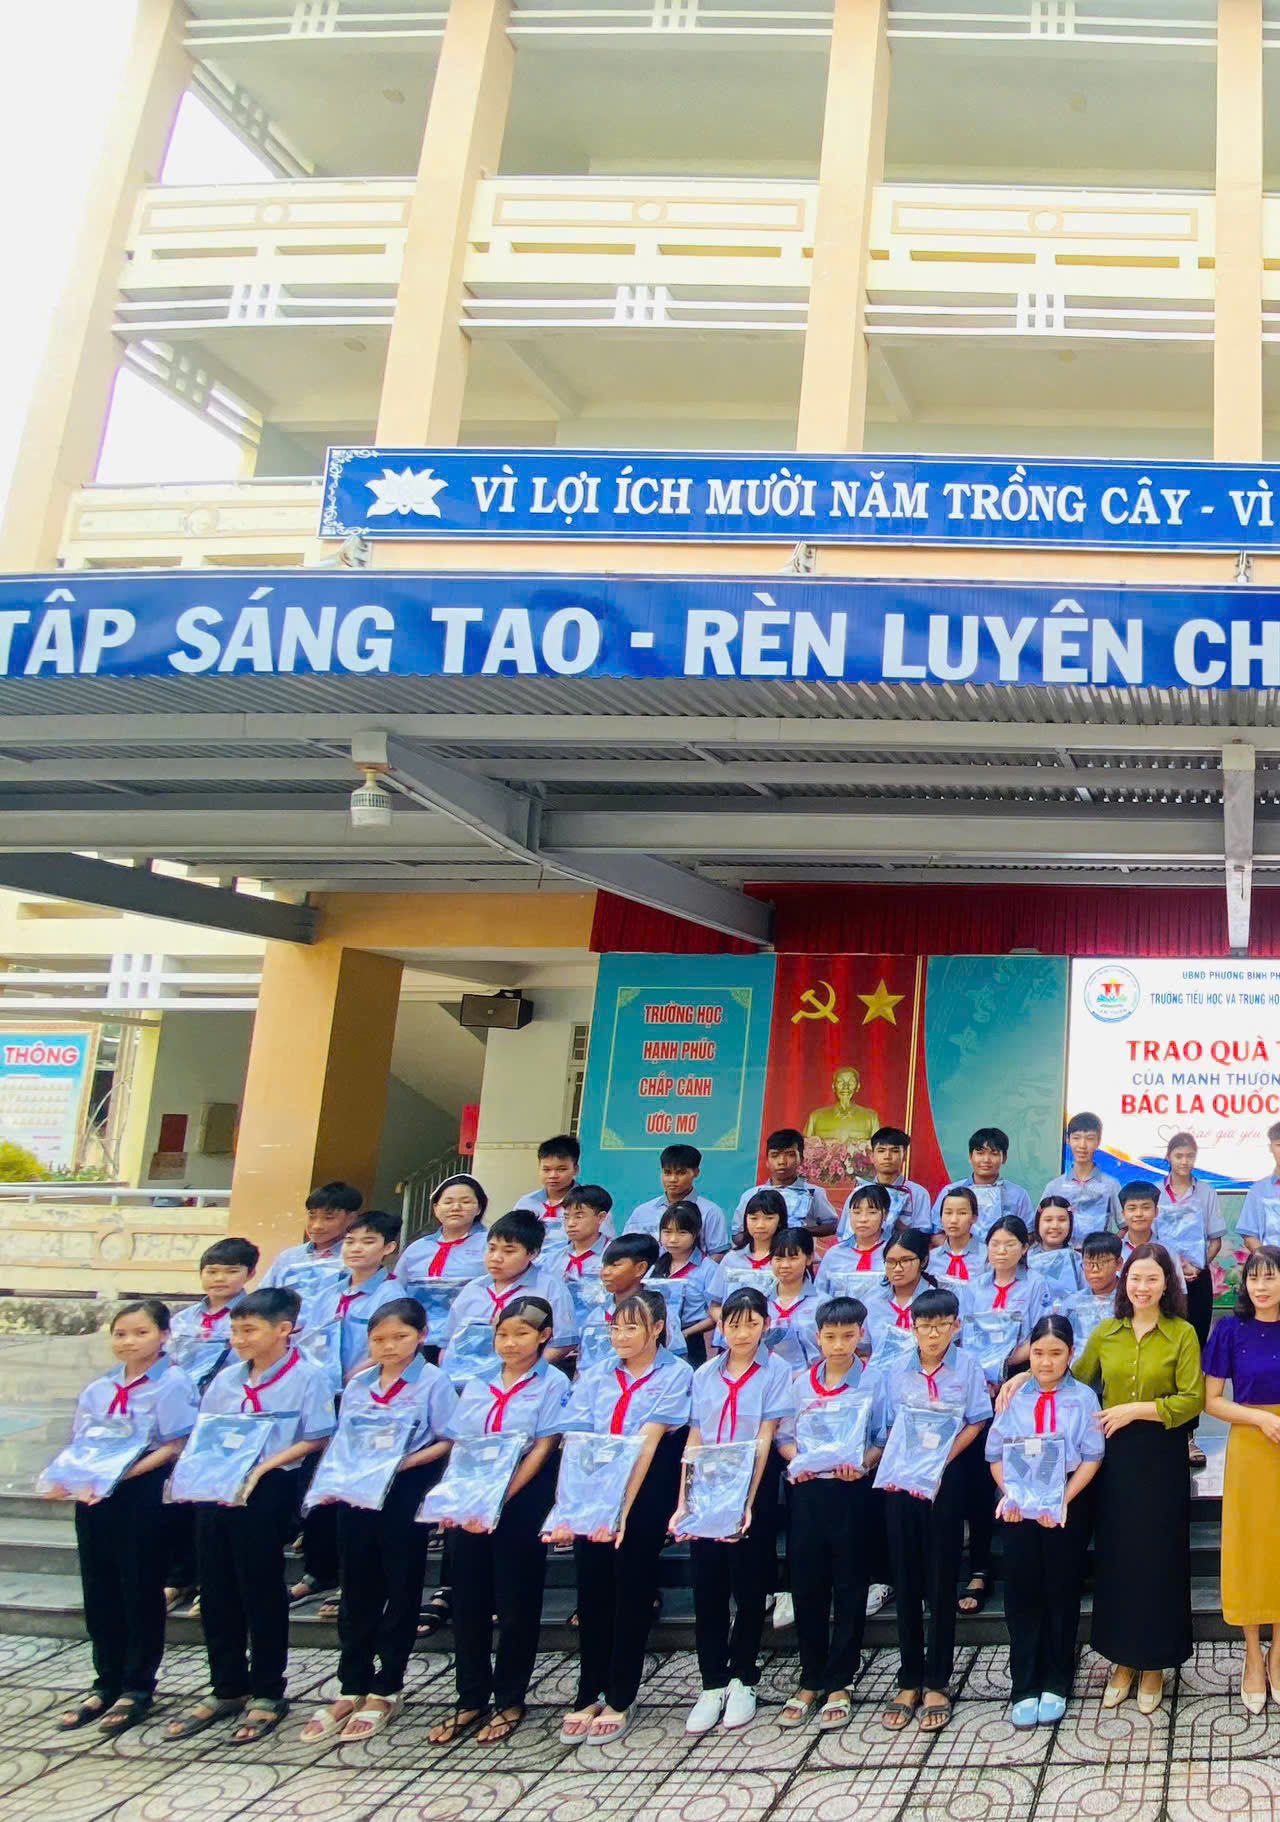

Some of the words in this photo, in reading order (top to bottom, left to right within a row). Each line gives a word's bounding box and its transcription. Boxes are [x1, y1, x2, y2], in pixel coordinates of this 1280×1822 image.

[472, 465, 517, 513] VÌ
[529, 472, 600, 525] LỢI
[613, 466, 693, 514] ÍCH
[705, 467, 817, 517] MƯỜI
[829, 471, 930, 519] NĂM
[943, 465, 1087, 523] TRỒNG
[1101, 477, 1191, 525] CÂY
[1229, 479, 1274, 527] VÌ
[168, 586, 394, 673] SÁNG
[684, 593, 847, 676] RÈN
[1239, 992, 1265, 1005] TRUNG
[645, 1000, 695, 1024] TRƯỜNG
[696, 1005, 723, 1028] HỌC
[643, 1040, 679, 1064] HẠNH
[681, 1037, 716, 1061] PHÚC
[1126, 1040, 1203, 1062] TRAO
[1210, 1035, 1270, 1066] QUÀ
[1121, 1088, 1169, 1115] BÁC
[1176, 1093, 1206, 1115] LA
[1211, 1087, 1280, 1119] QUỐC
[646, 1109, 673, 1134] ƯỚC
[674, 1112, 699, 1134] MƠ
